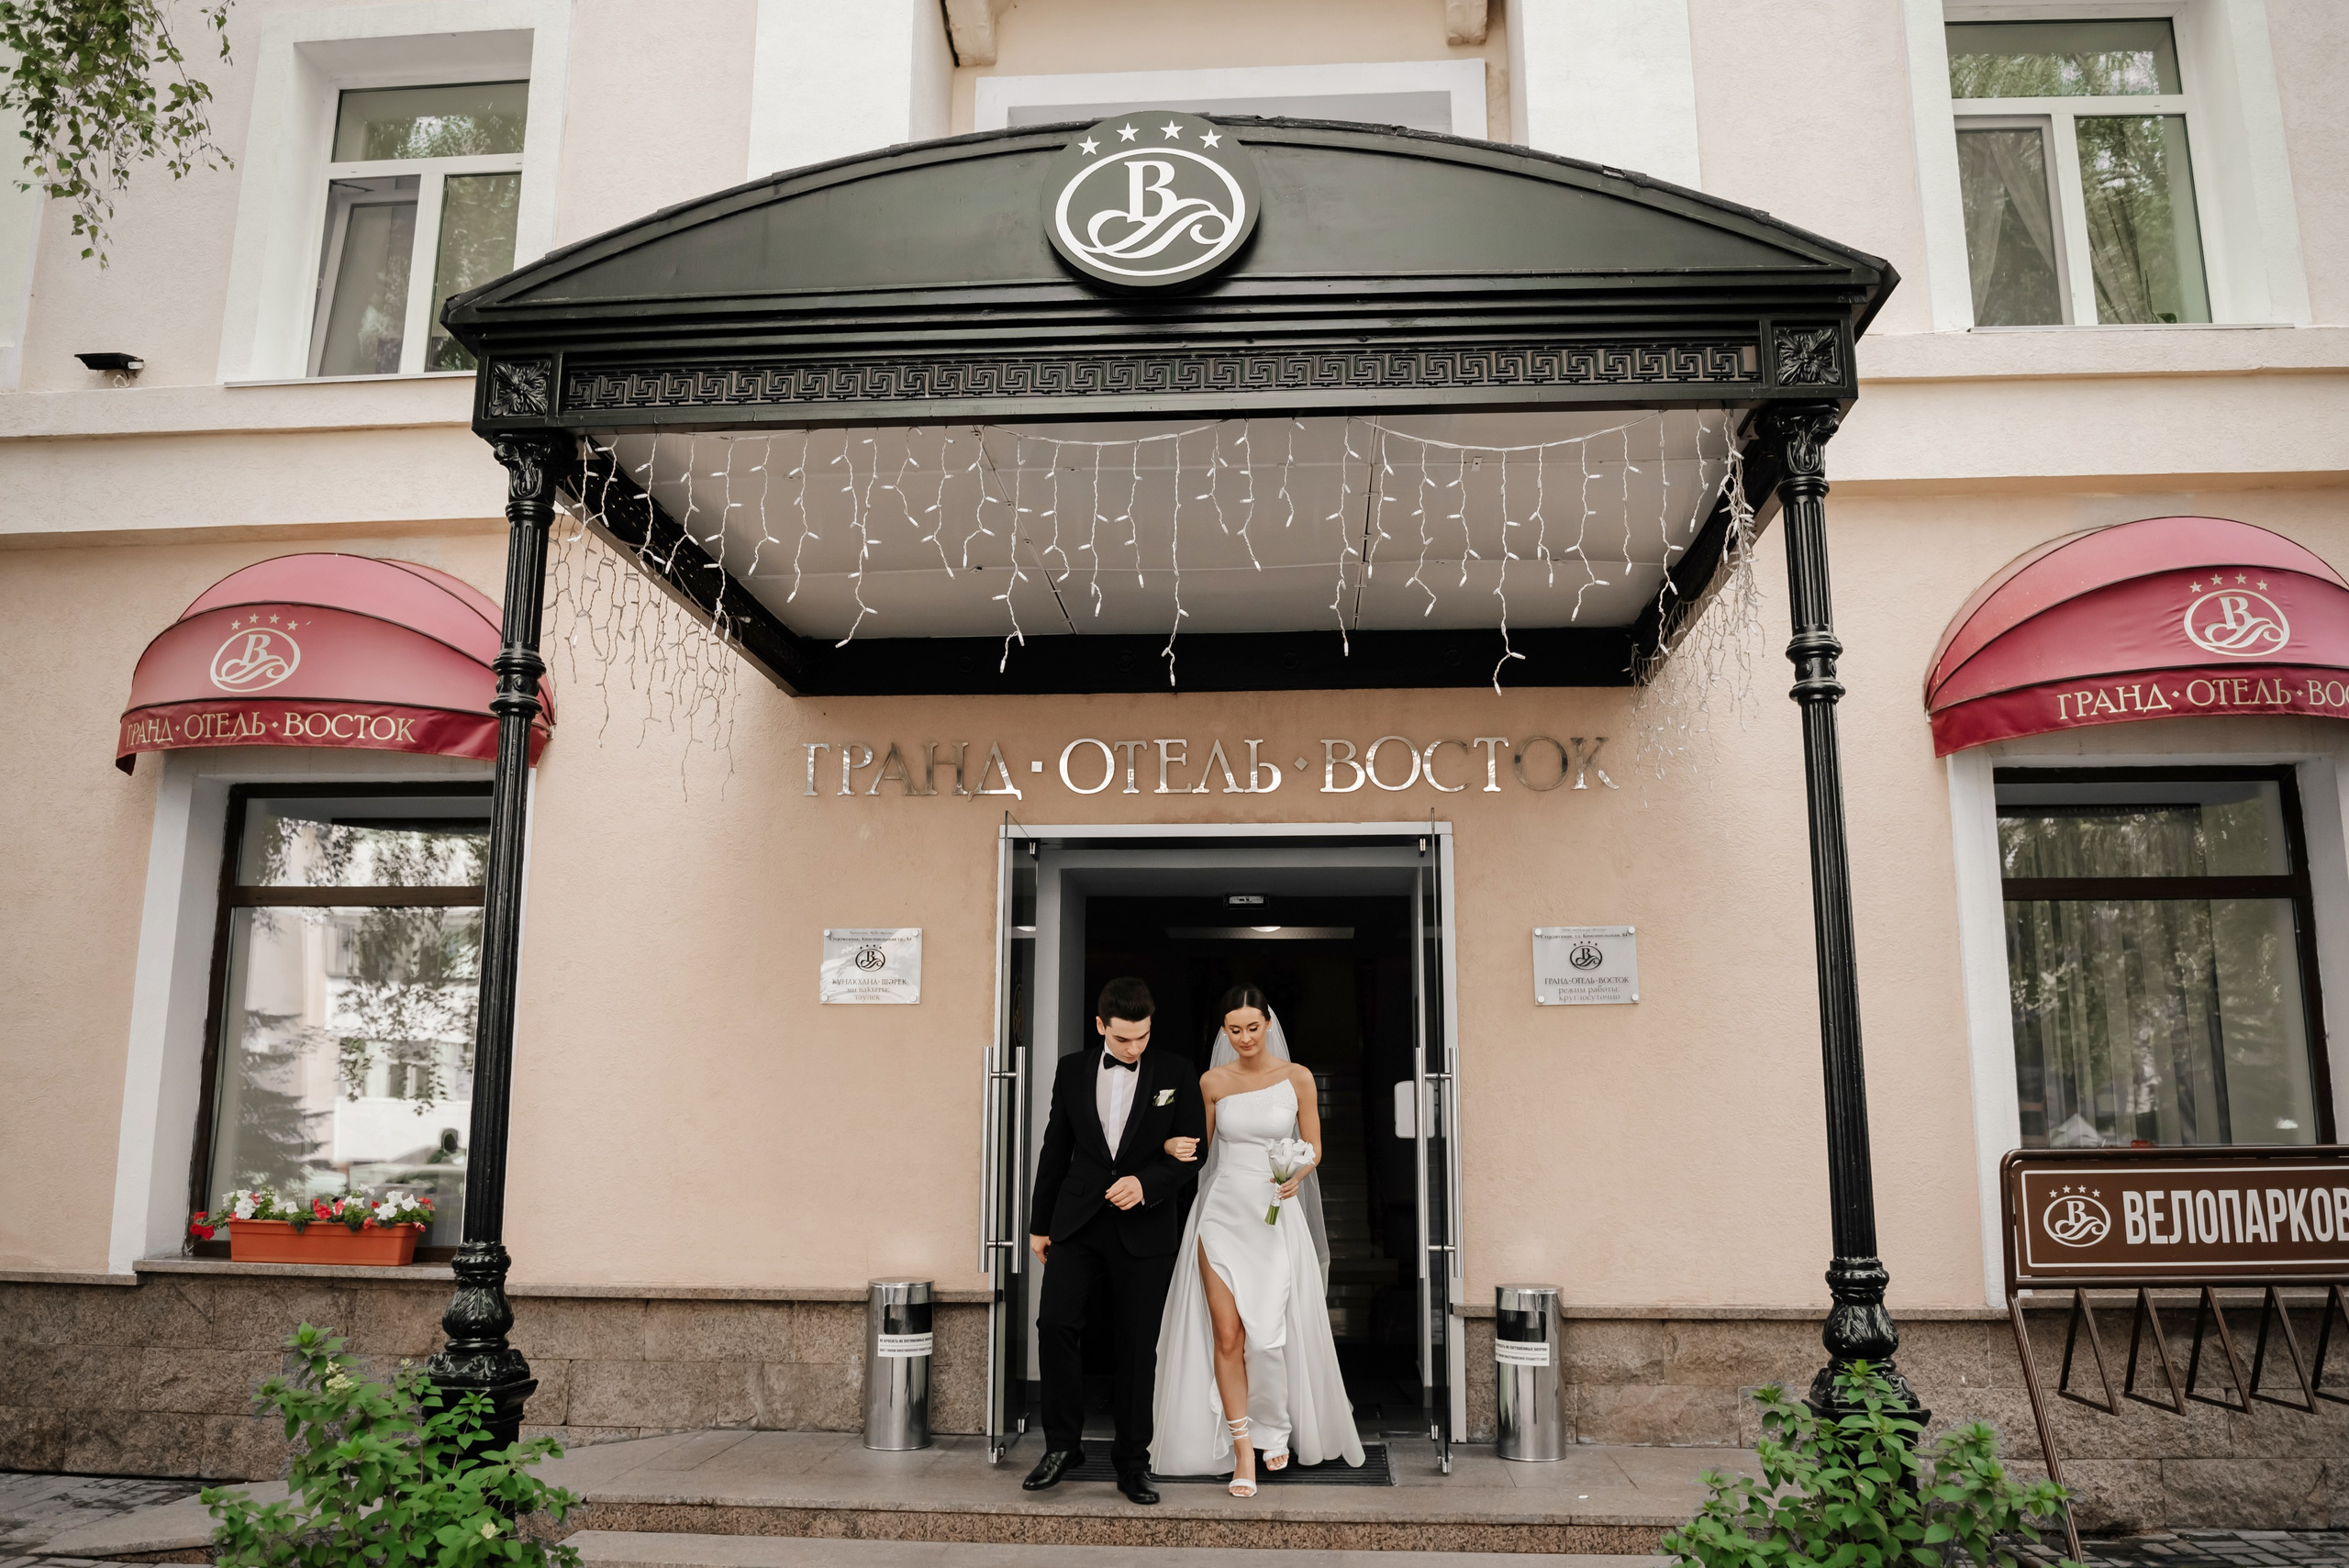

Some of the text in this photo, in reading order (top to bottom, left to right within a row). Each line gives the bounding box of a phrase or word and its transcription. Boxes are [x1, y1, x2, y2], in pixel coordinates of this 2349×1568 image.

[2057, 684, 2172, 719] ГРАНД
[2187, 678, 2292, 706] ОТЕЛЬ
[126, 711, 416, 748] ГРАНД ОТЕЛЬ ВОСТОК
[801, 735, 1620, 801] ГРАНД ОТЕЛЬ ВОСТОК
[1544, 977, 1569, 985] ГРАНД
[1558, 987, 1586, 995] режим
[1558, 995, 1620, 1003] круглосуточно
